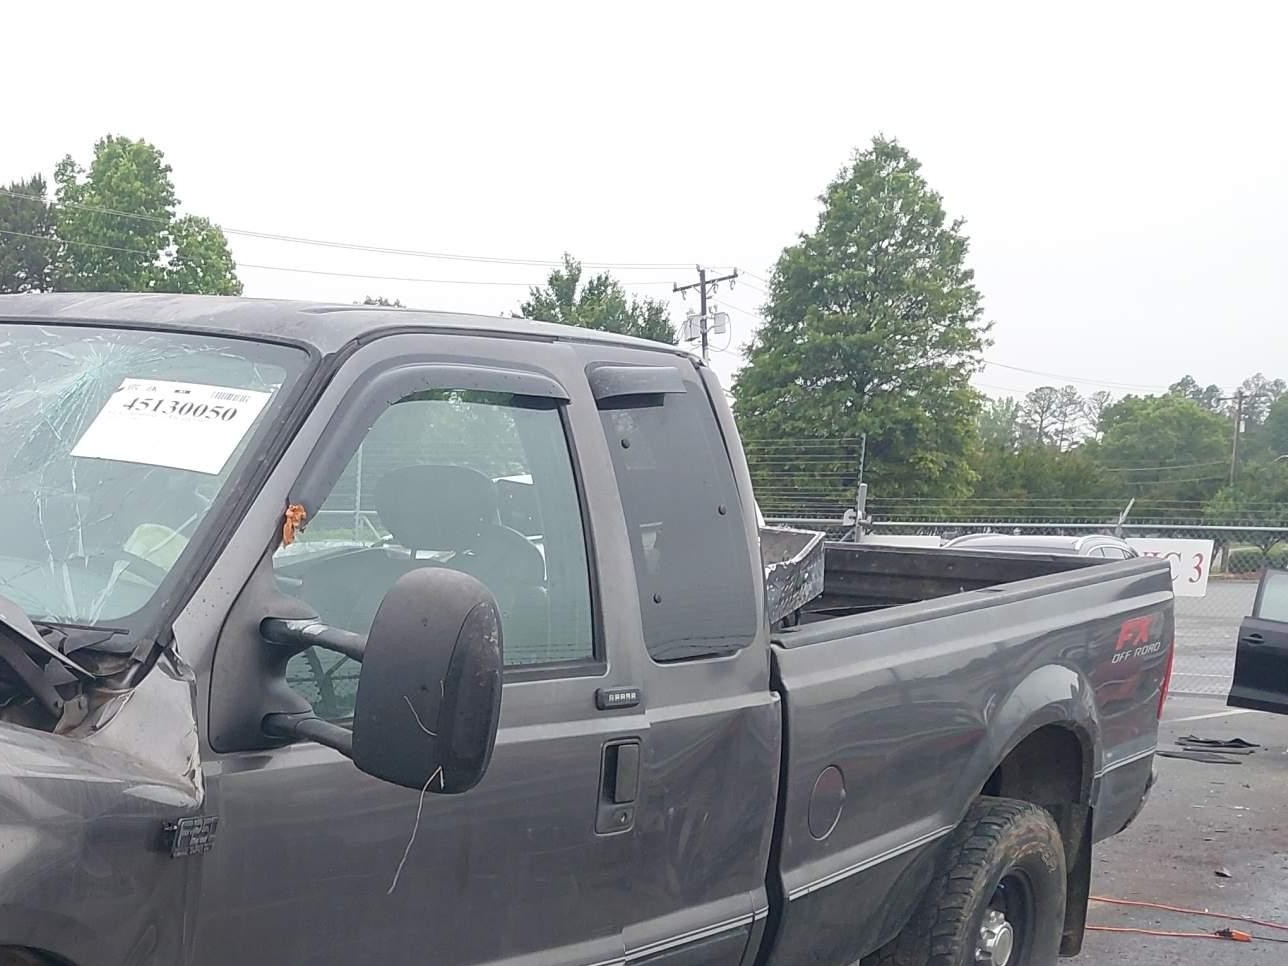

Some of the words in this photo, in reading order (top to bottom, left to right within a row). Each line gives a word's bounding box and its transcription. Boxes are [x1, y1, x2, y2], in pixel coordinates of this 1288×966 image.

[122, 397, 237, 420] 45130050
[1188, 553, 1204, 583] 3
[1112, 650, 1132, 664] OFF
[1133, 641, 1161, 657] ROAD
